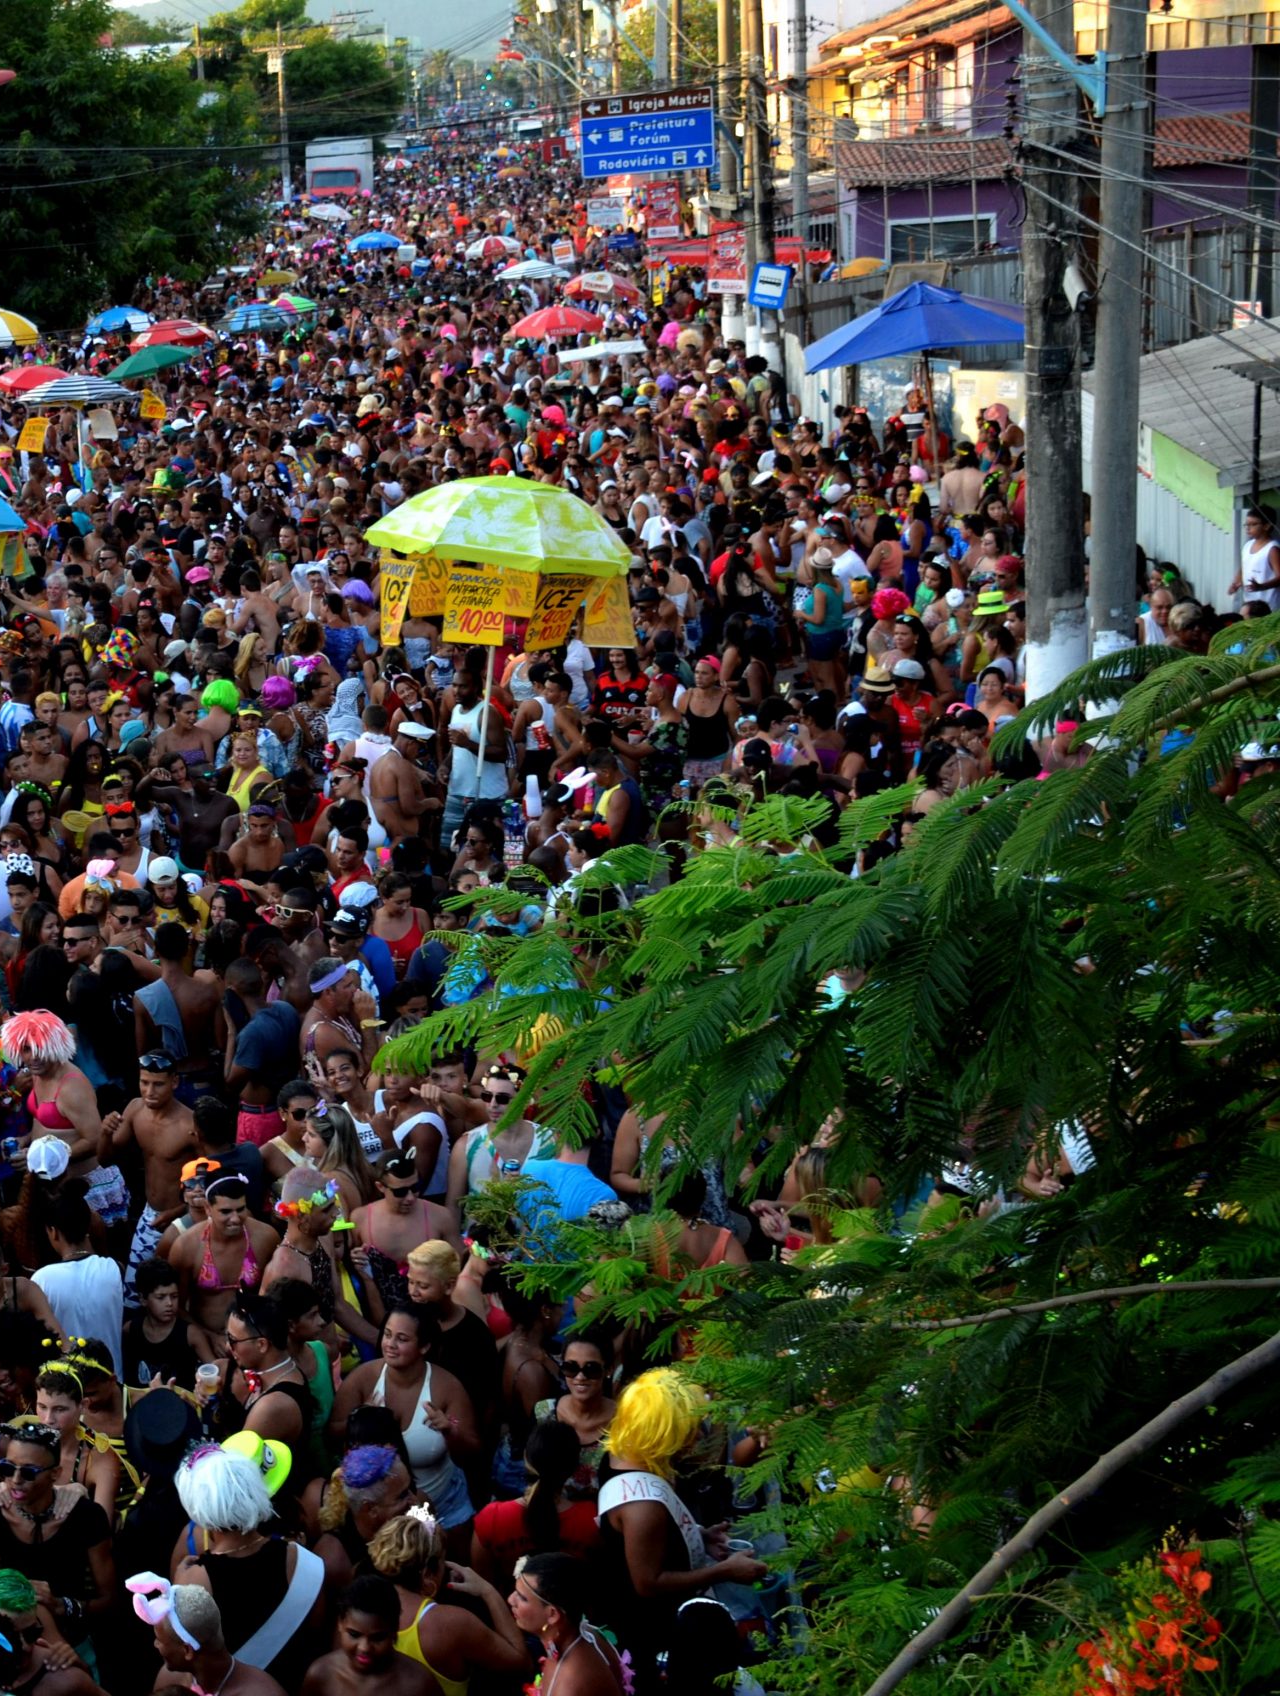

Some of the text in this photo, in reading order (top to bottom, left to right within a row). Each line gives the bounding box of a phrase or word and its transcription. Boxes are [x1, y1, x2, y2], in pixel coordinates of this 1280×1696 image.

[628, 94, 710, 113] Igreja Matriz
[629, 117, 696, 131] Prefeitura
[630, 132, 671, 146] Forúm
[598, 155, 667, 170] Rodoviária
[589, 199, 622, 210] CNA
[452, 594, 493, 609] LATINHA
[535, 589, 585, 610] ICE
